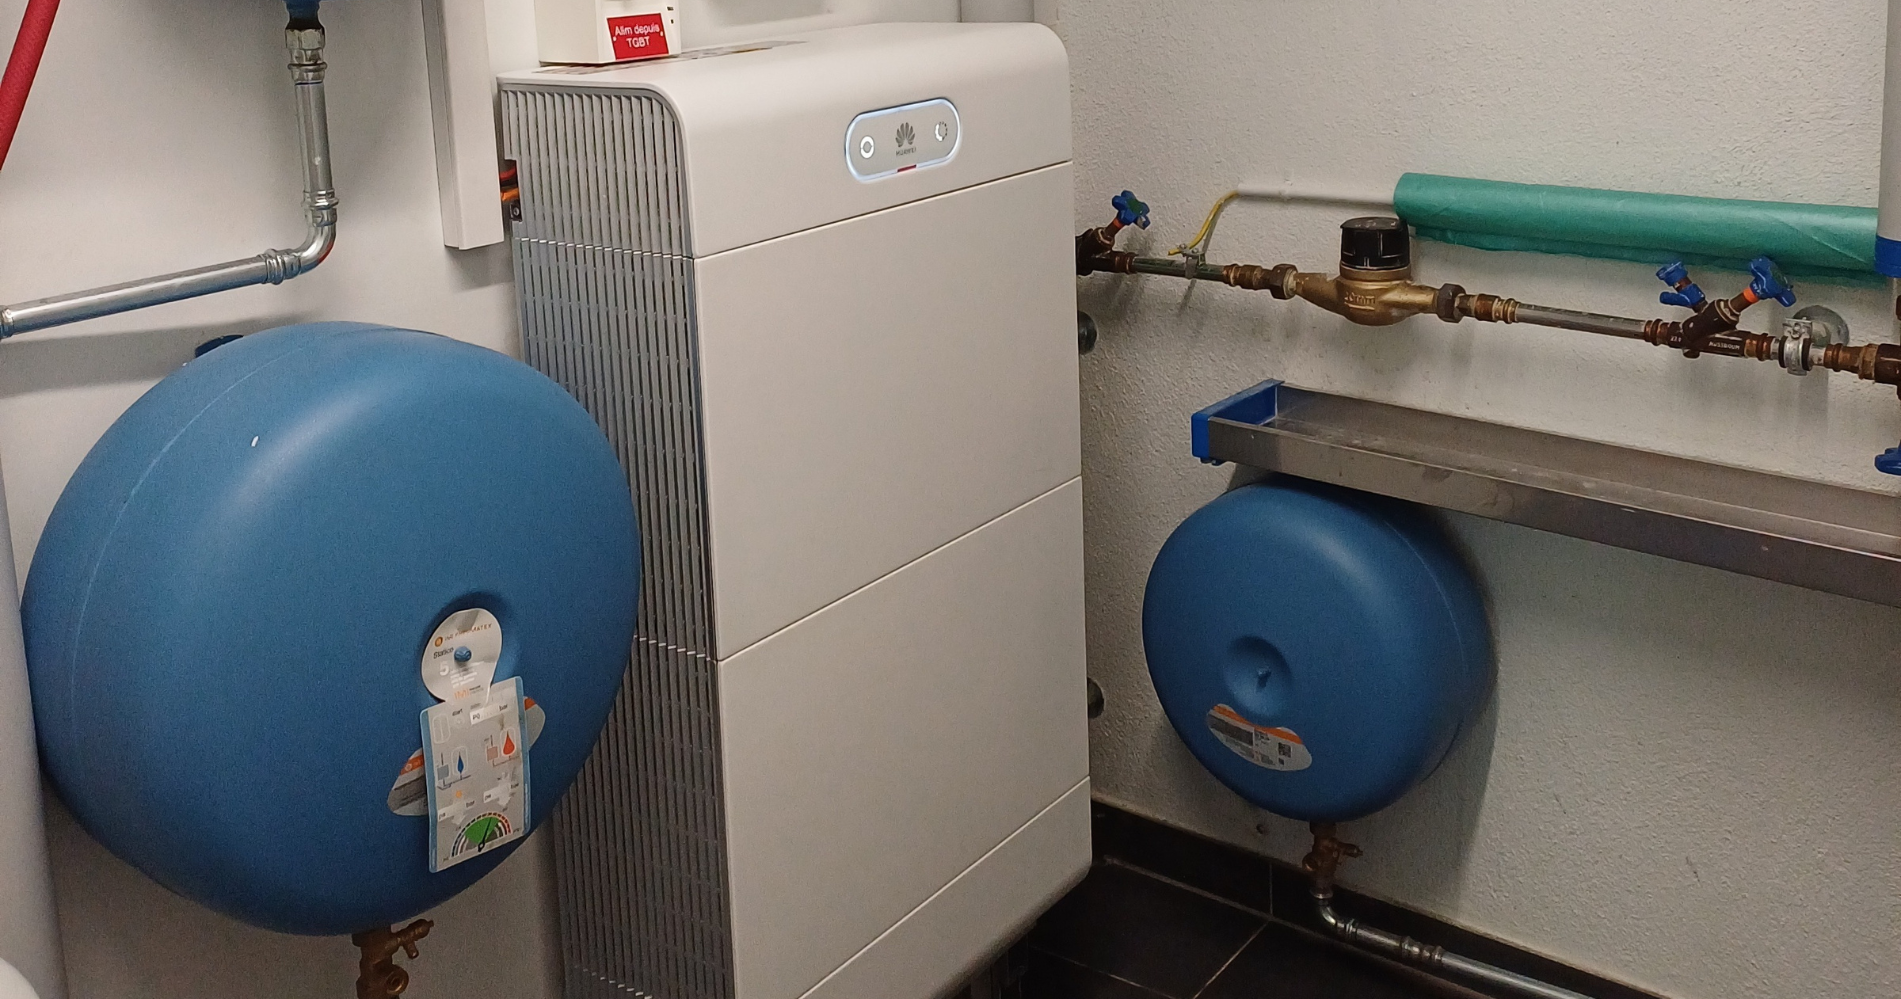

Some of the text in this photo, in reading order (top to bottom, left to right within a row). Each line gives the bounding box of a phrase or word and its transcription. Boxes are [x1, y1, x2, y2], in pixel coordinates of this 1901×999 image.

[615, 22, 660, 36] Alim depuis
[626, 36, 650, 48] TGBT
[440, 661, 450, 676] 5
